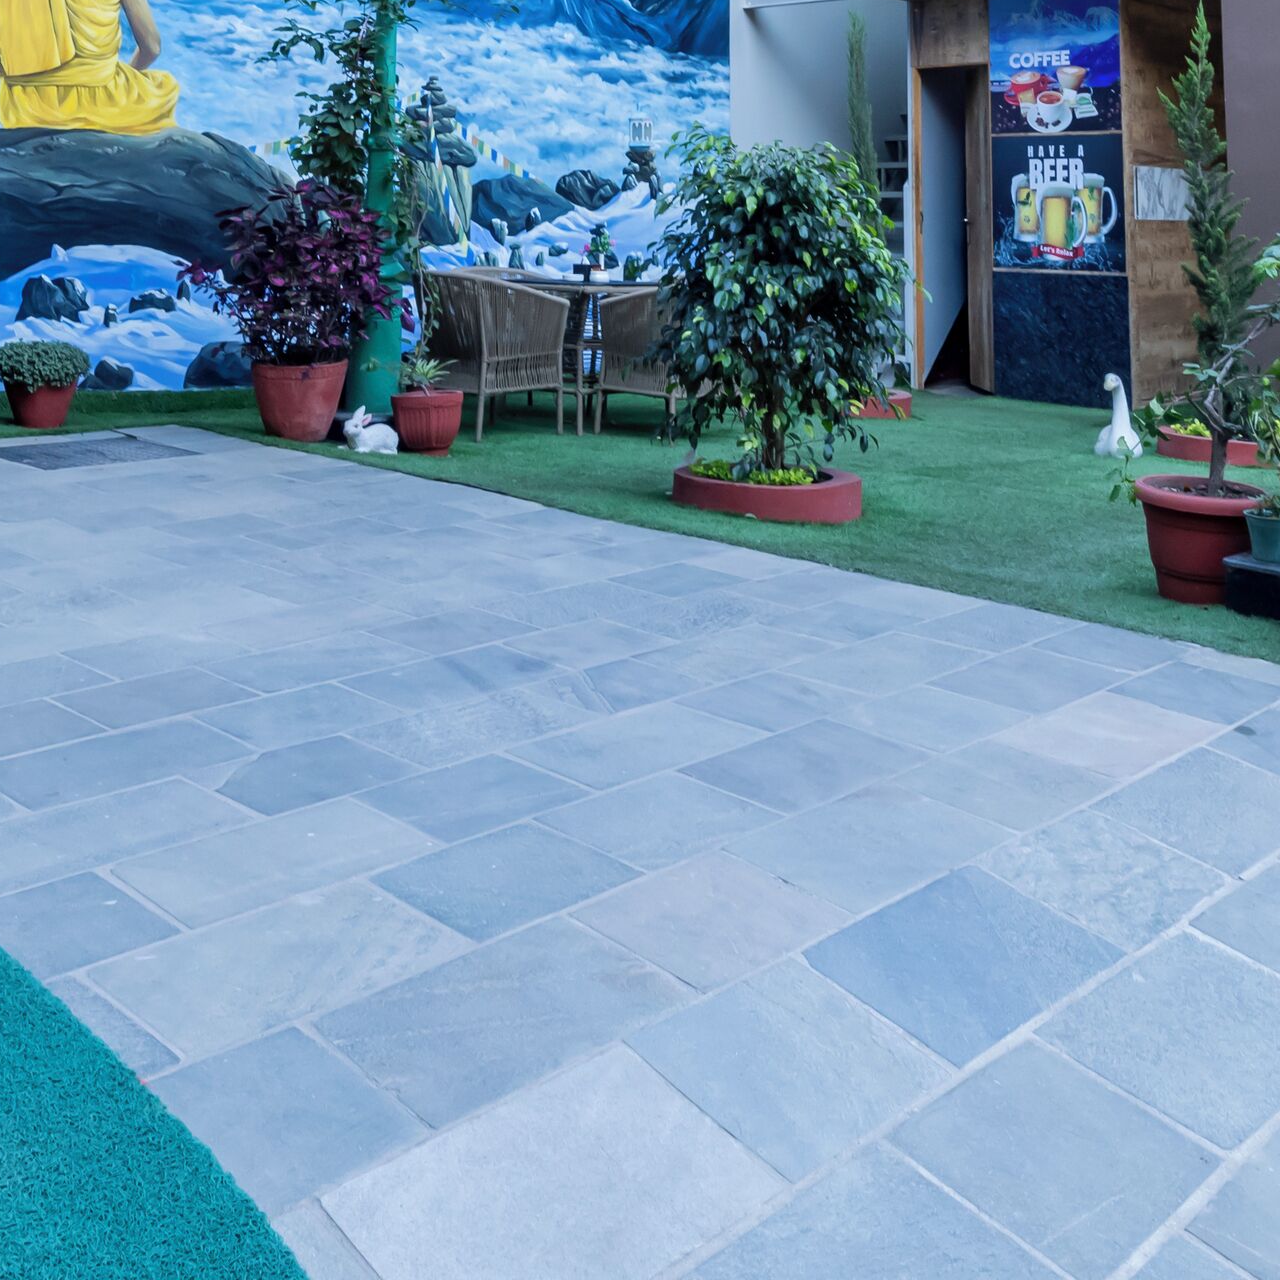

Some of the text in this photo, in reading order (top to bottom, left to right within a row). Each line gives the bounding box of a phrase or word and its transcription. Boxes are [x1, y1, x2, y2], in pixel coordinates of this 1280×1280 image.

[1009, 49, 1071, 69] COFFEE
[1027, 144, 1084, 158] HAVE A
[1029, 158, 1084, 190] BEER
